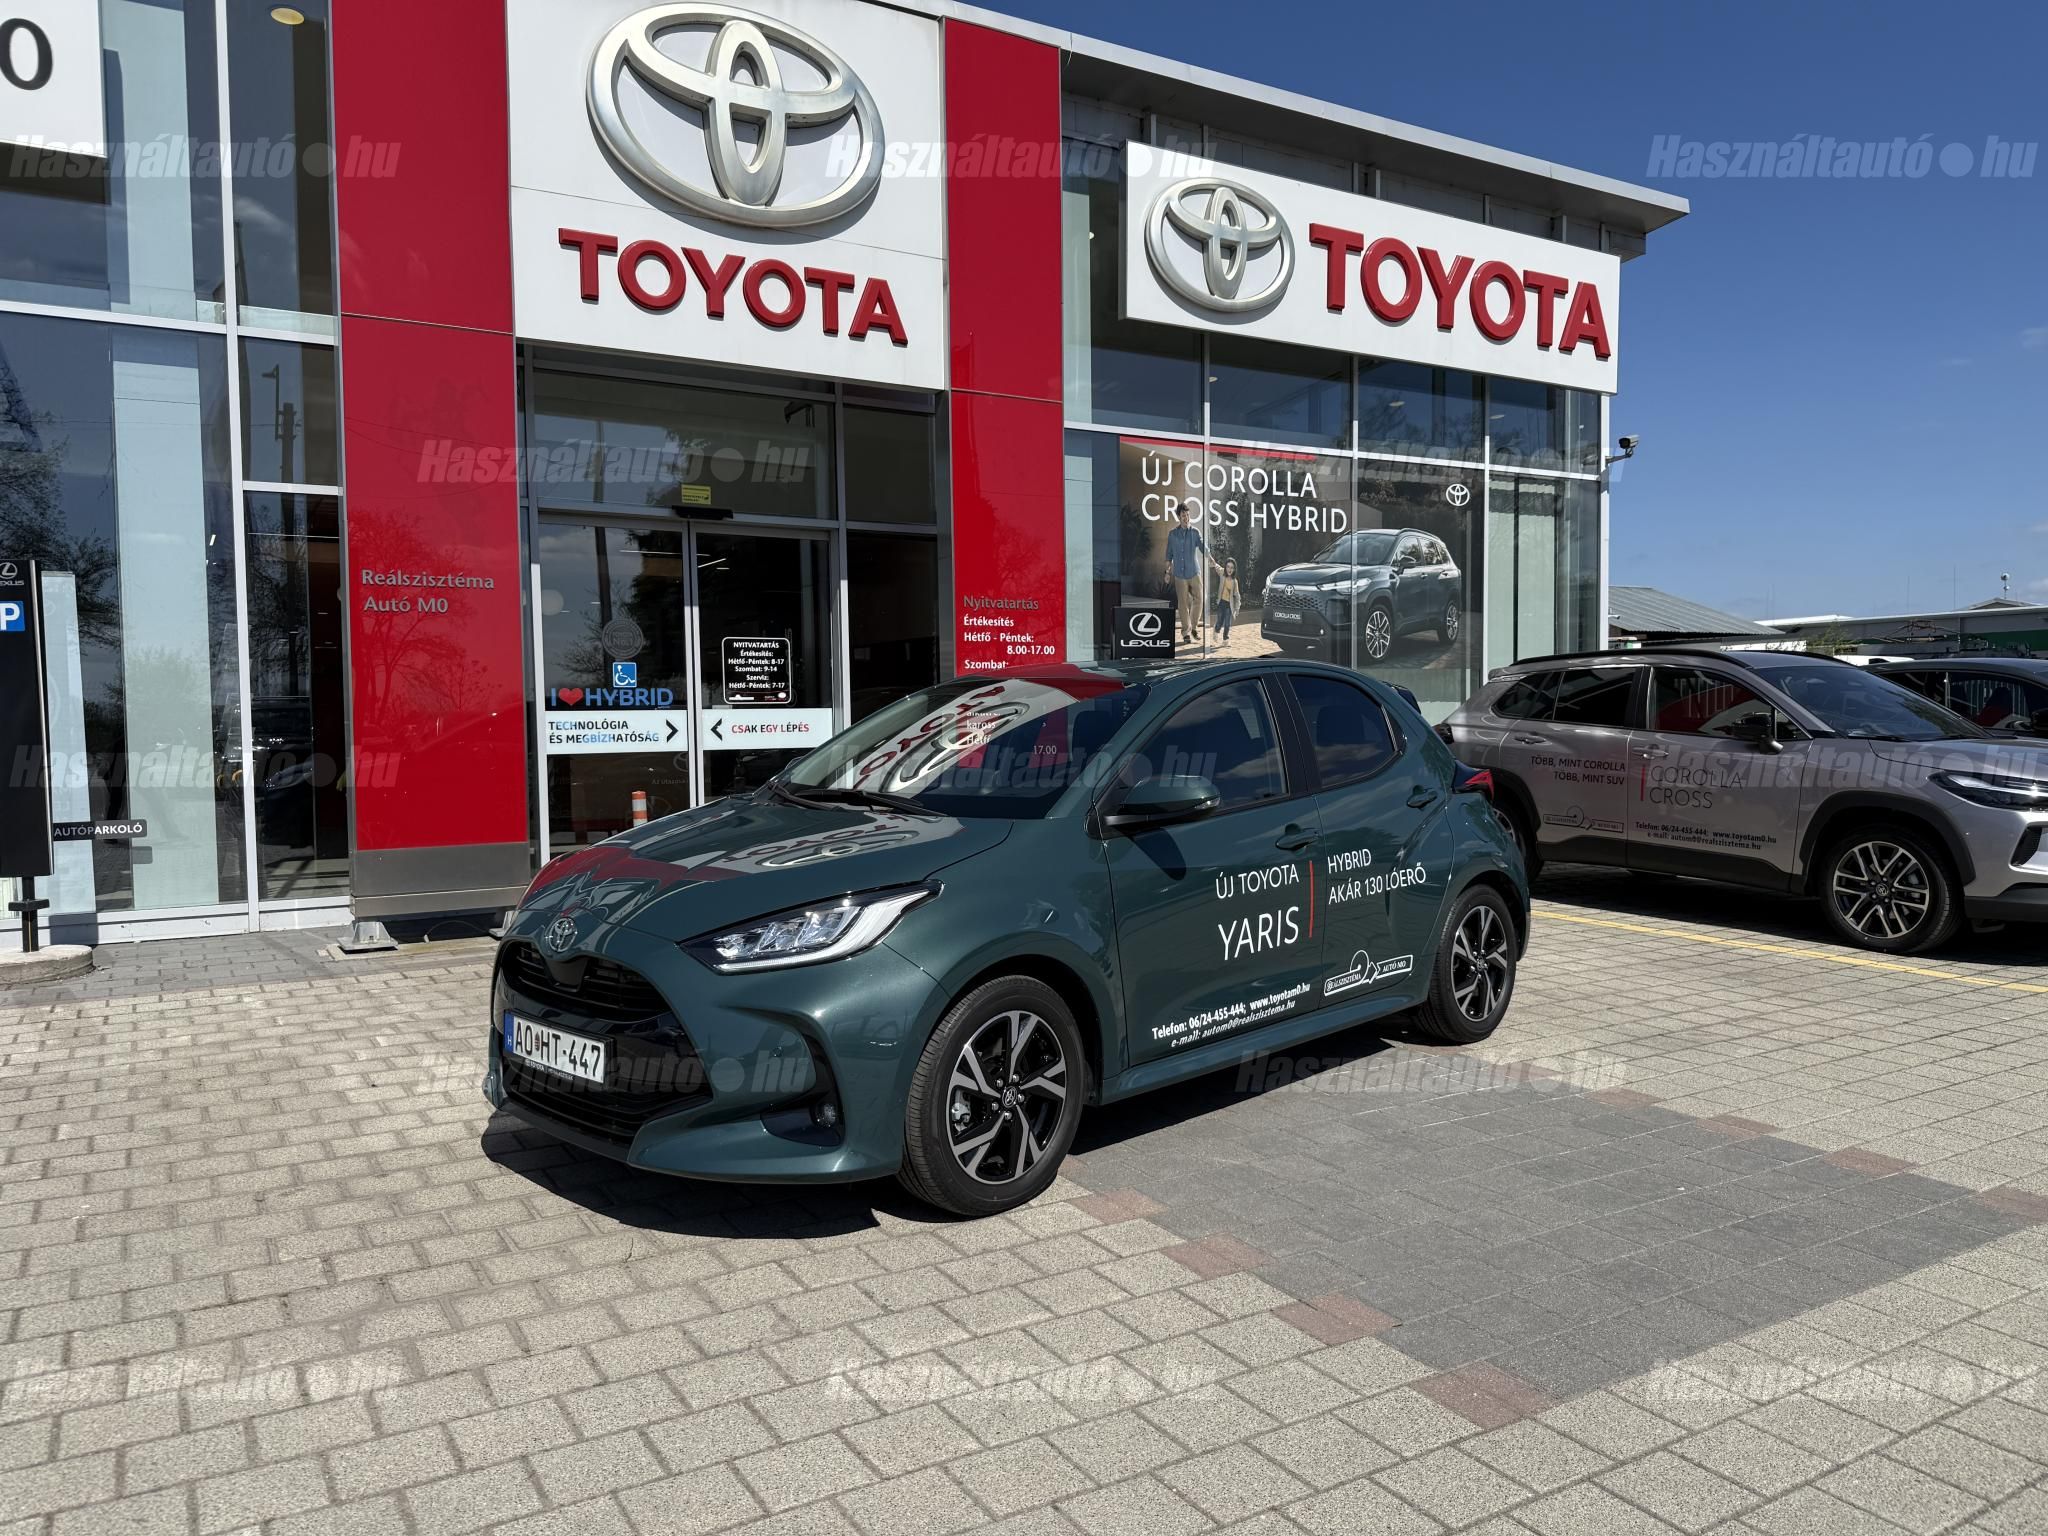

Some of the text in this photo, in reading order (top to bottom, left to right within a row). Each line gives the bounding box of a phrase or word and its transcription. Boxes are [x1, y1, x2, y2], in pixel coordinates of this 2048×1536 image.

[558, 227, 908, 346] TOYOTA
[1309, 223, 1611, 360] TOYOTA
[1142, 451, 1317, 498] ÚJ COROLLA
[1141, 494, 1347, 534] CROSS HYBRID
[362, 569, 494, 588] Reálszisztéma
[364, 596, 411, 612] Autó
[963, 595, 1040, 611] Nyitvatartás
[0, 602, 20, 631] P
[963, 614, 1014, 626] Értékesítés
[733, 641, 780, 649] NYITVATARTÁS
[964, 632, 991, 642] Hétfő
[1000, 632, 1034, 643] Péntek:
[1120, 640, 1170, 648] LEXUS
[1006, 645, 1055, 654] 8.00-17.00
[585, 687, 674, 706] HYBRID
[548, 718, 628, 730] TECHNOLÓGIA
[731, 721, 810, 734] CSAK EGY LÉPÉS
[550, 730, 659, 744] ÉS MEGBÍZHATÓSÁG
[1033, 745, 1057, 755] 17.00
[1530, 756, 1626, 772] TÖBB, MINT COROLLA
[1554, 770, 1625, 785] TÖBB, MINT SUV
[1651, 766, 1743, 790] COROLLA
[1650, 787, 1713, 809] CROSS
[54, 822, 142, 836] AUTÓPARKOLÓ
[1636, 821, 1660, 832] Telefon:
[1328, 848, 1372, 874] HYBRID
[1216, 864, 1300, 899] ÚJ TOYOTA
[1328, 862, 1427, 904] AKÁR 130 LÓERŐ
[1218, 906, 1299, 960] YARIS
[1152, 1021, 1188, 1040] Telefon:
[1250, 982, 1310, 1010] www.toyotam0.hu
[1171, 1030, 1200, 1048] e-mail:
